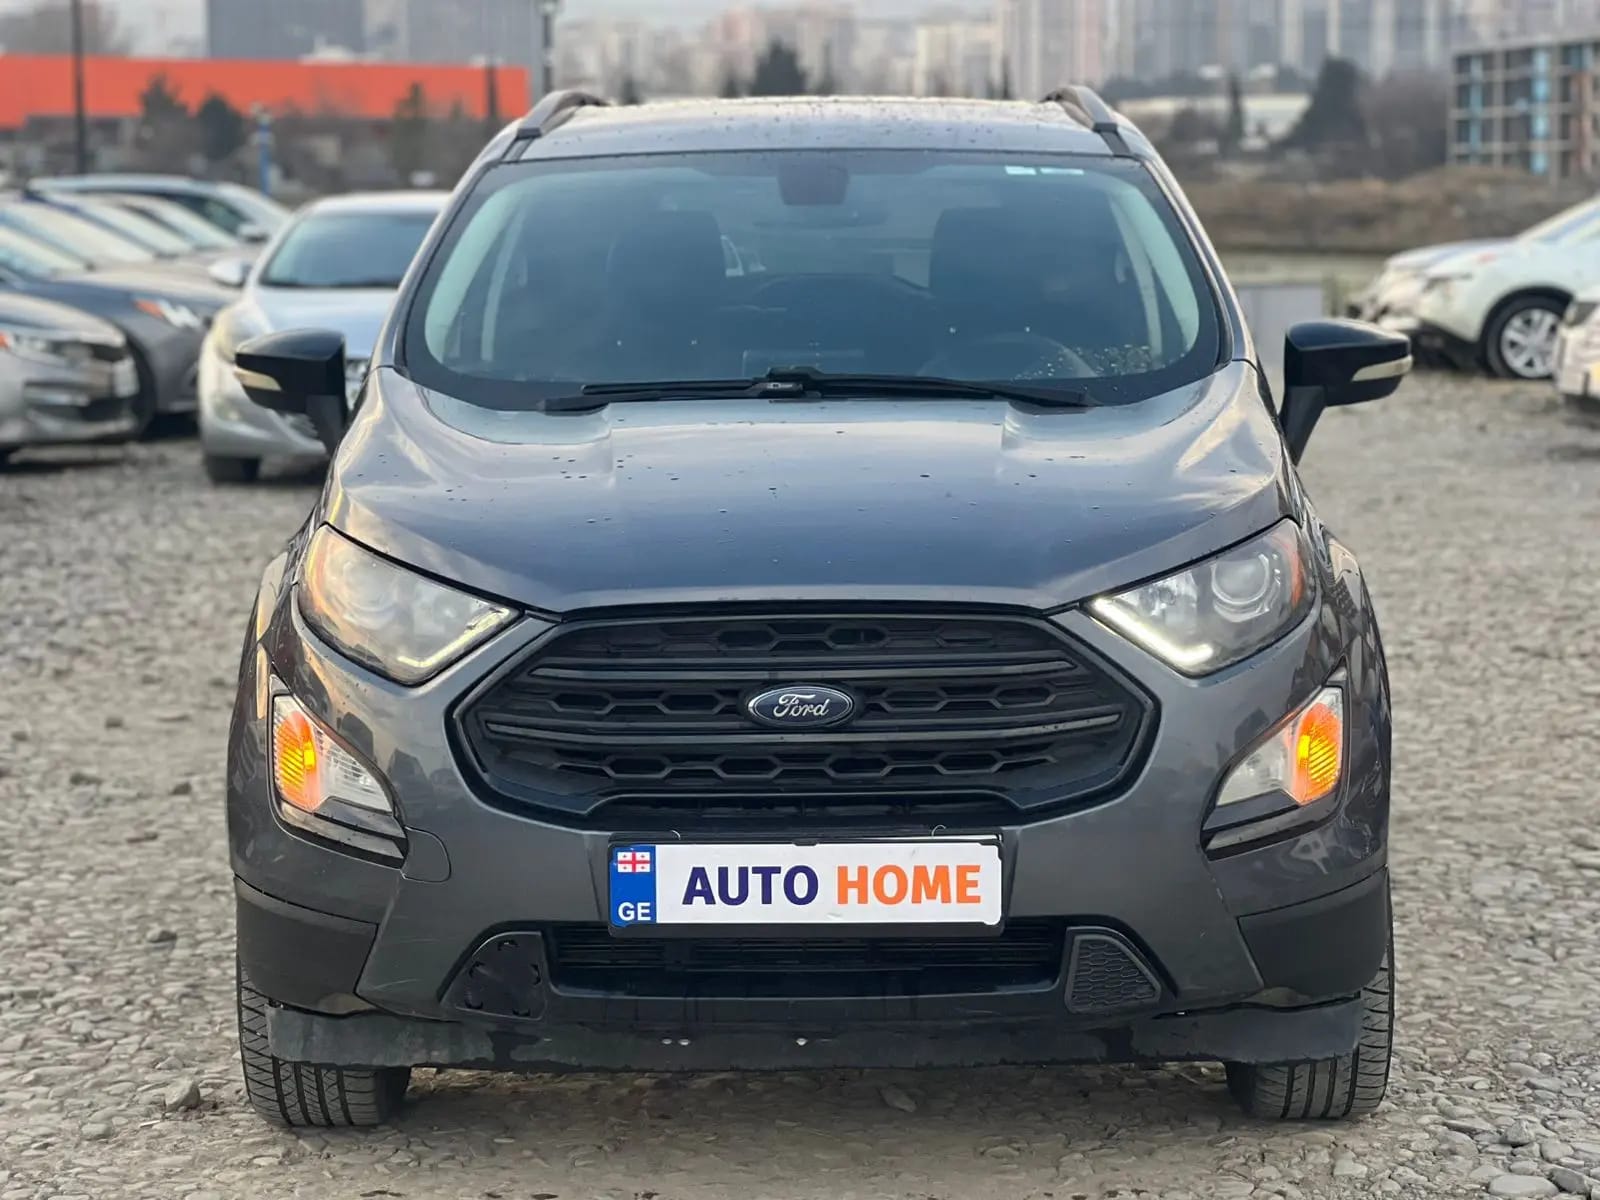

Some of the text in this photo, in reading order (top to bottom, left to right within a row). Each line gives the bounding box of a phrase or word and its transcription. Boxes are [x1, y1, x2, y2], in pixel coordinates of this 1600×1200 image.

[773, 693, 830, 717] Ford
[682, 865, 981, 905] AUTO HOME
[617, 902, 652, 922] GE
